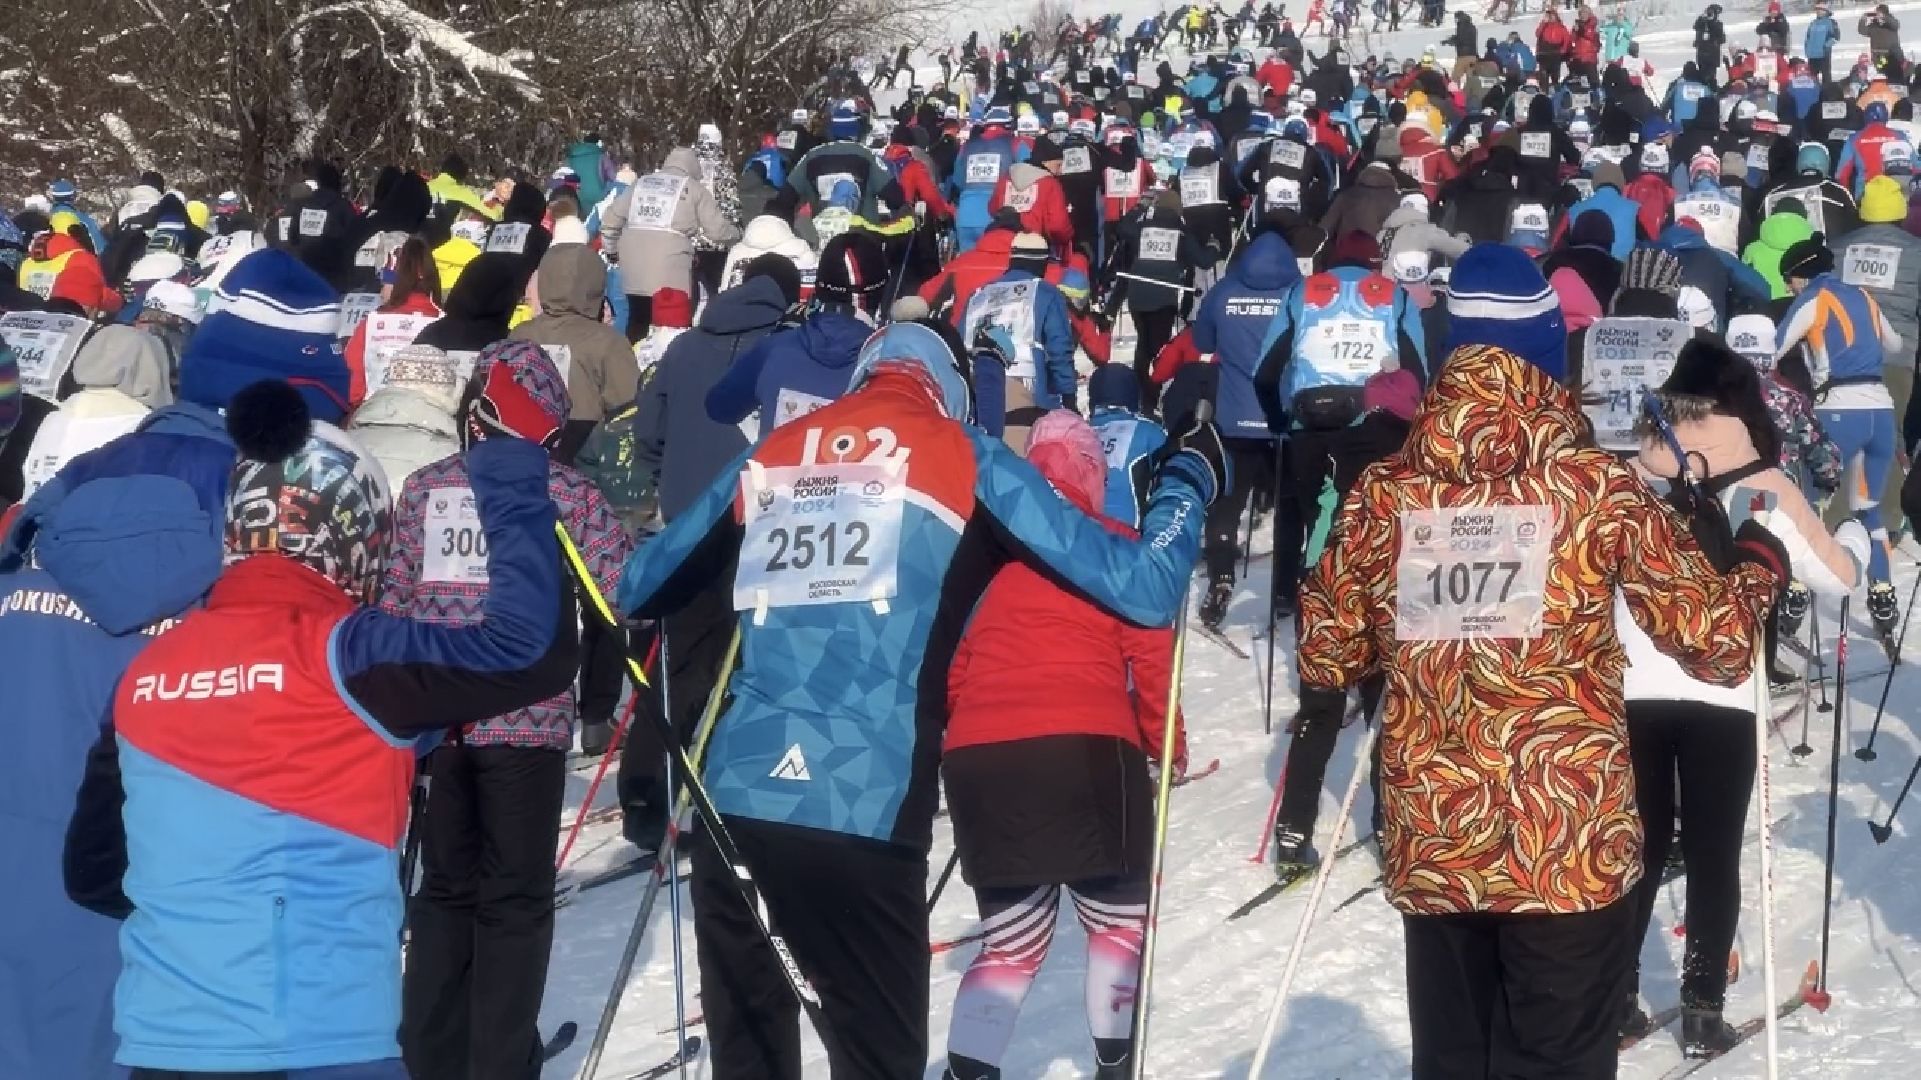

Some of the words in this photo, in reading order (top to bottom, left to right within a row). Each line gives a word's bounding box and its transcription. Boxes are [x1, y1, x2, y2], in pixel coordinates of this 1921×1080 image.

[1698, 203, 1720, 216] 549
[1146, 239, 1172, 252] 9923
[1852, 259, 1888, 276] 7000
[1595, 327, 1639, 337] ЛЫЖНЯ
[1594, 335, 1639, 348] РОССИИ
[1330, 341, 1374, 360] 1722
[793, 475, 839, 488] ЛЫЖНЯ
[793, 487, 837, 499] РОССИИ
[791, 499, 835, 514] 2024
[1450, 515, 1494, 526] ЛЫЖНЯ
[1450, 525, 1493, 537] РОССИИ
[765, 521, 870, 572] 2512
[1450, 539, 1492, 550] 2024
[808, 579, 858, 590] МОСКОВСКАЯ
[1427, 561, 1521, 606] 1077
[808, 588, 842, 598] ОБЛАСТЬ
[132, 663, 284, 705] RUSSIA
